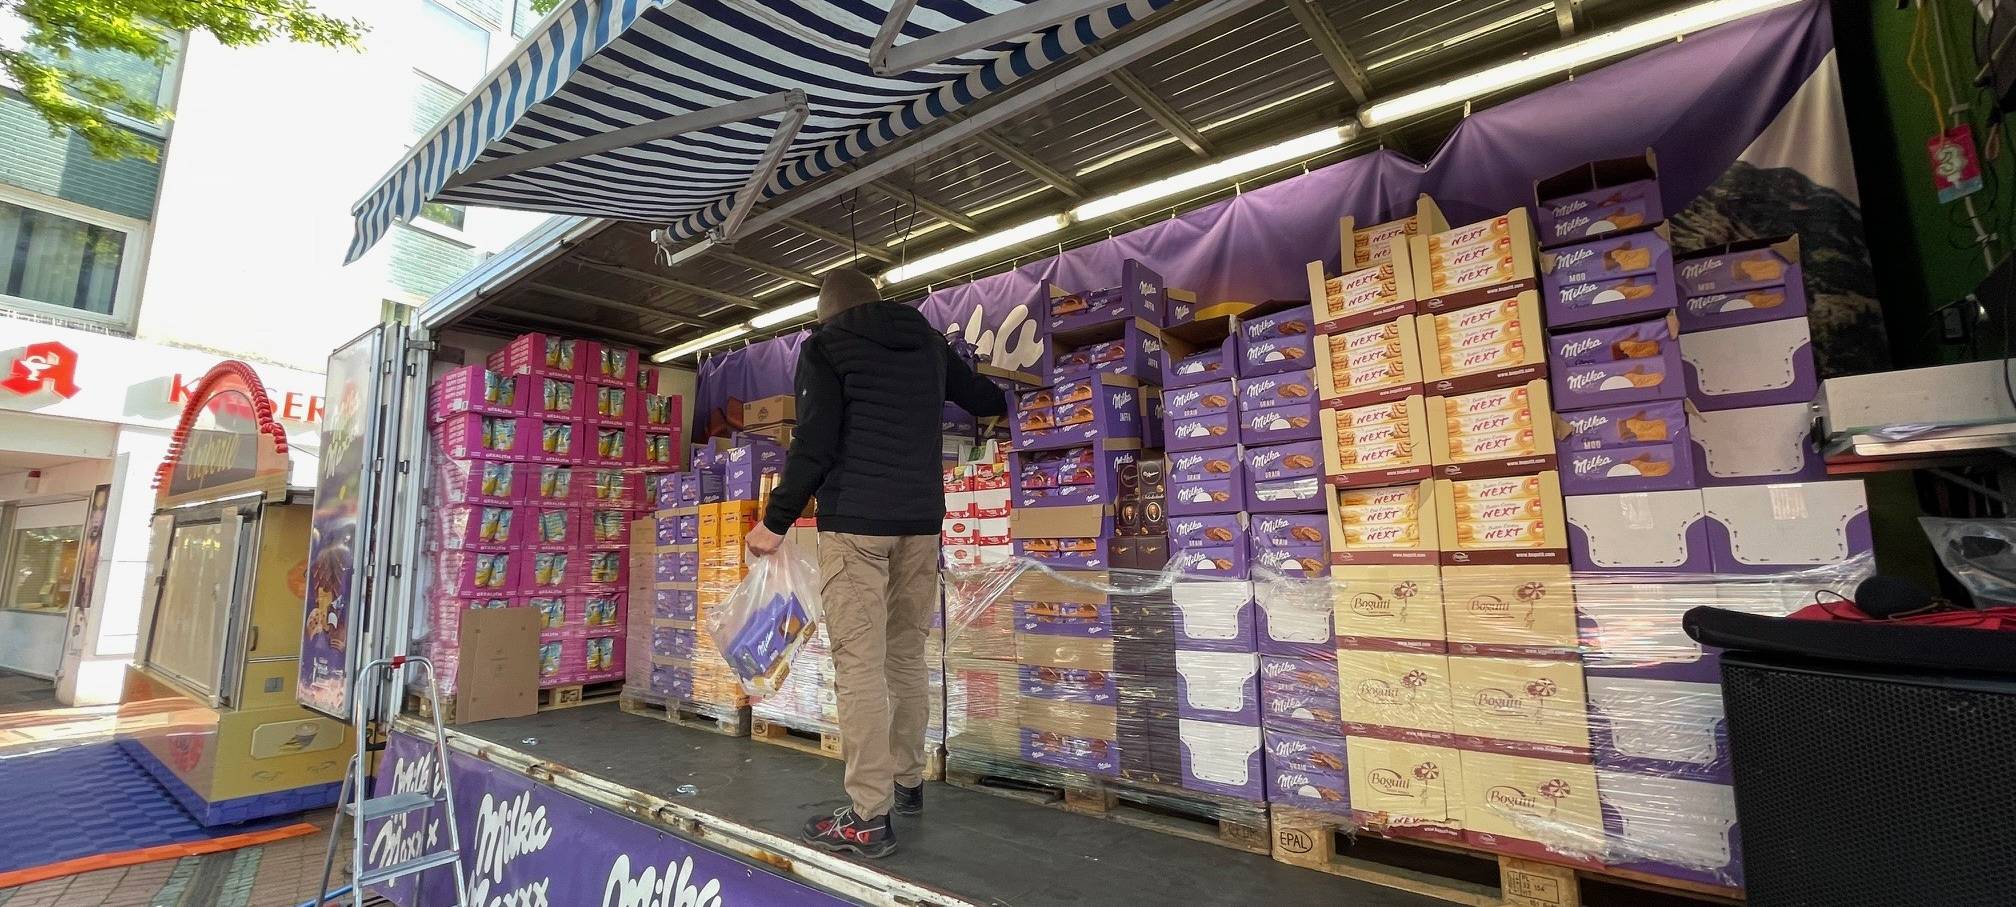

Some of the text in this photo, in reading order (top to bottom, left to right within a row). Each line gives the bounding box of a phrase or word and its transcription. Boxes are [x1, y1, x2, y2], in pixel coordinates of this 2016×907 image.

[1552, 200, 1588, 217] Milka
[1555, 216, 1590, 237] Milka
[1372, 229, 1401, 243] NEXT
[1452, 228, 1487, 246] NEXT
[1454, 247, 1489, 265] NEXT
[1557, 248, 1594, 270] Milka
[1458, 266, 1493, 283] NEXT
[1682, 259, 1723, 279] Milka
[1346, 273, 1377, 290] NEXT
[1348, 290, 1378, 307] NEXT
[1560, 283, 1598, 303] Milka
[1460, 310, 1496, 327] NEXT
[1248, 320, 1275, 338] Milka
[1351, 332, 1381, 347] NEXT
[1462, 330, 1498, 347] NEXT
[1247, 343, 1275, 360] Milka
[1560, 338, 1602, 358] Milka
[1353, 350, 1383, 366] NEXT
[1464, 350, 1500, 366] NEXT
[1355, 369, 1386, 384] NEXT
[1567, 370, 1606, 390] Milka
[1247, 380, 1276, 398] Milka
[1112, 391, 1132, 410] Milka
[1173, 391, 1199, 407] Milka
[1469, 397, 1506, 412] NEXT
[1251, 411, 1281, 429] Milka
[1357, 411, 1388, 424] NEXT
[1472, 417, 1509, 431] NEXT
[1569, 415, 1608, 434] Milka
[1360, 430, 1391, 443] NEXT
[1475, 438, 1511, 452] NEXT
[1176, 454, 1203, 471] Milka
[1252, 450, 1281, 468] Milka
[1362, 449, 1394, 462] NEXT
[1573, 455, 1612, 474] Milka
[1177, 486, 1204, 502] Milka
[1374, 493, 1405, 505] NEXT
[1480, 485, 1518, 497] NEXT
[1367, 510, 1399, 521] NEXT
[1483, 507, 1521, 518] NEXT
[1176, 520, 1204, 536] Milka
[1260, 518, 1289, 534] Milka
[1485, 528, 1523, 540] NEXT
[1367, 530, 1399, 541] NEXT
[1354, 598, 1390, 610] Bogutti
[1472, 601, 1510, 611] Bogutti
[1265, 662, 1296, 677] Milka
[1272, 699, 1301, 713] Milka
[1478, 693, 1523, 708] Bogutti
[1276, 741, 1307, 757] Milka
[1277, 774, 1309, 789] Milka
[1371, 773, 1410, 789] Bogutti
[1491, 790, 1536, 808] Bogutti
[474, 790, 553, 884] Milka
[1280, 832, 1307, 849] EPAL
